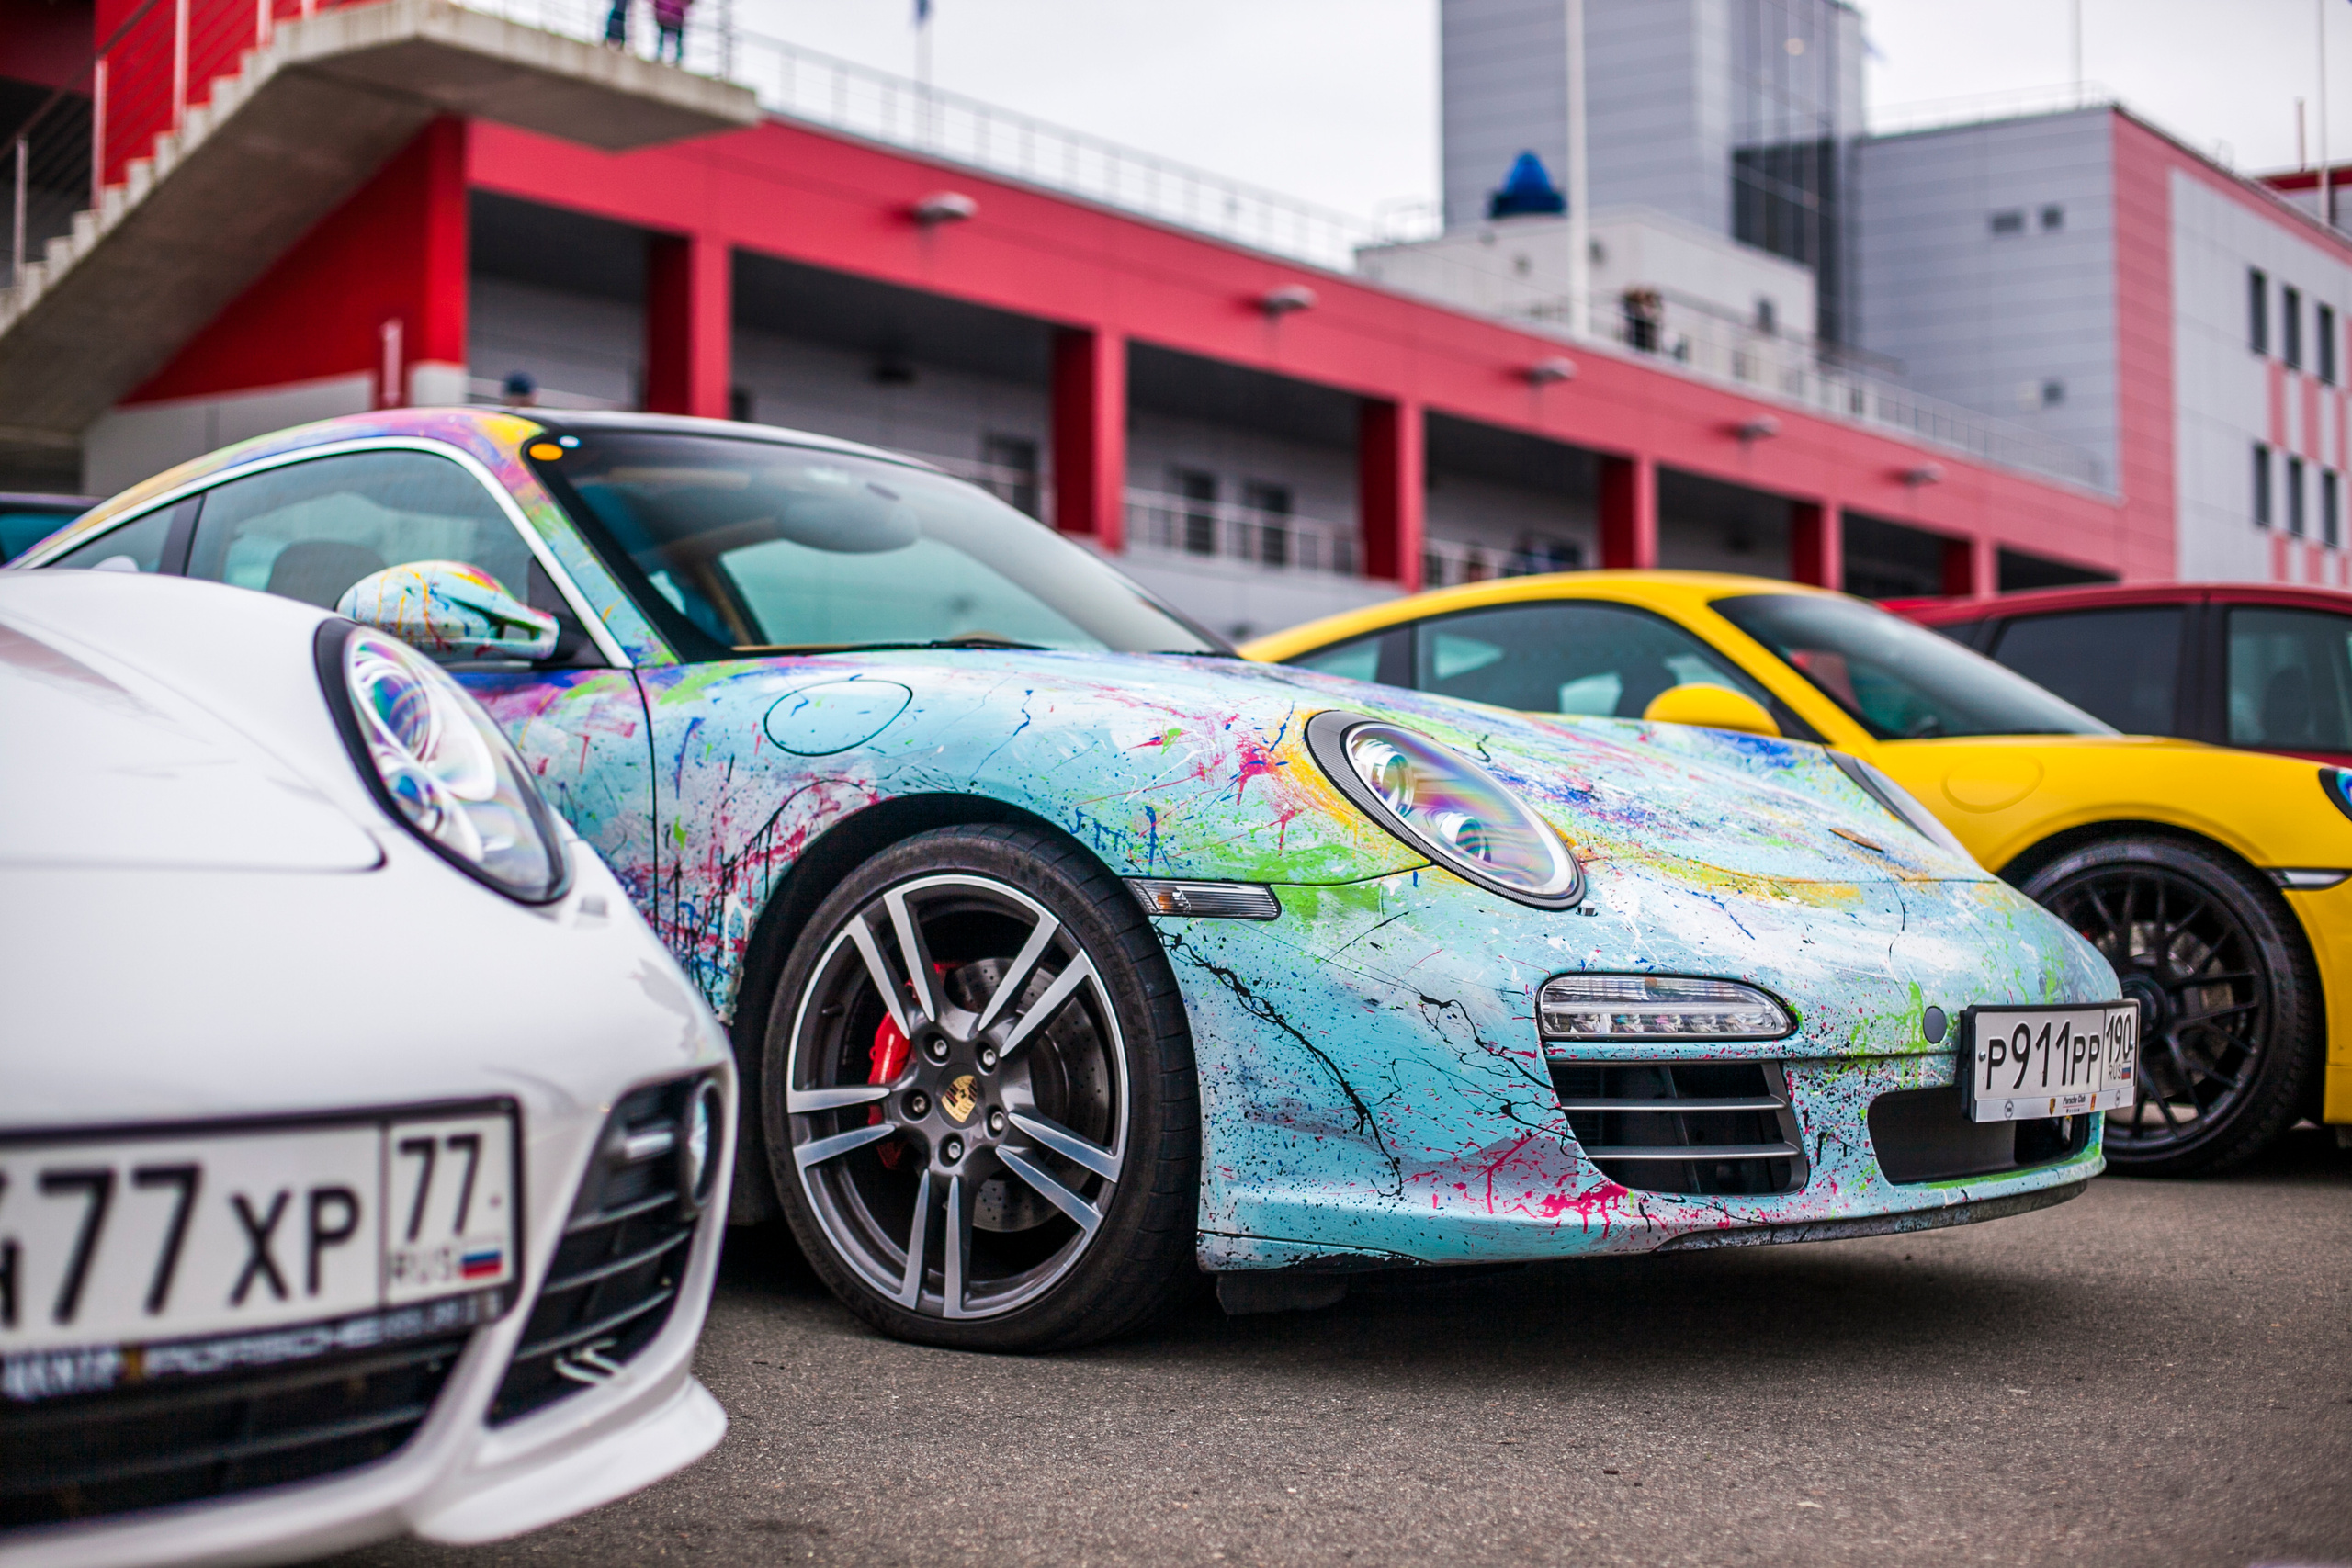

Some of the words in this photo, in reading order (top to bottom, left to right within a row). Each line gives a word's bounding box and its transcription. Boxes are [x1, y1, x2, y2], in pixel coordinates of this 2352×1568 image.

[1060, 894, 1135, 998] MICHELIN
[1985, 1021, 2101, 1090] Р911РР
[2106, 1013, 2132, 1064] 190
[2108, 1064, 2121, 1081] RUS
[2063, 1094, 2077, 1105] Porsche
[2077, 1093, 2086, 1103] Club
[396, 1132, 482, 1243] 77
